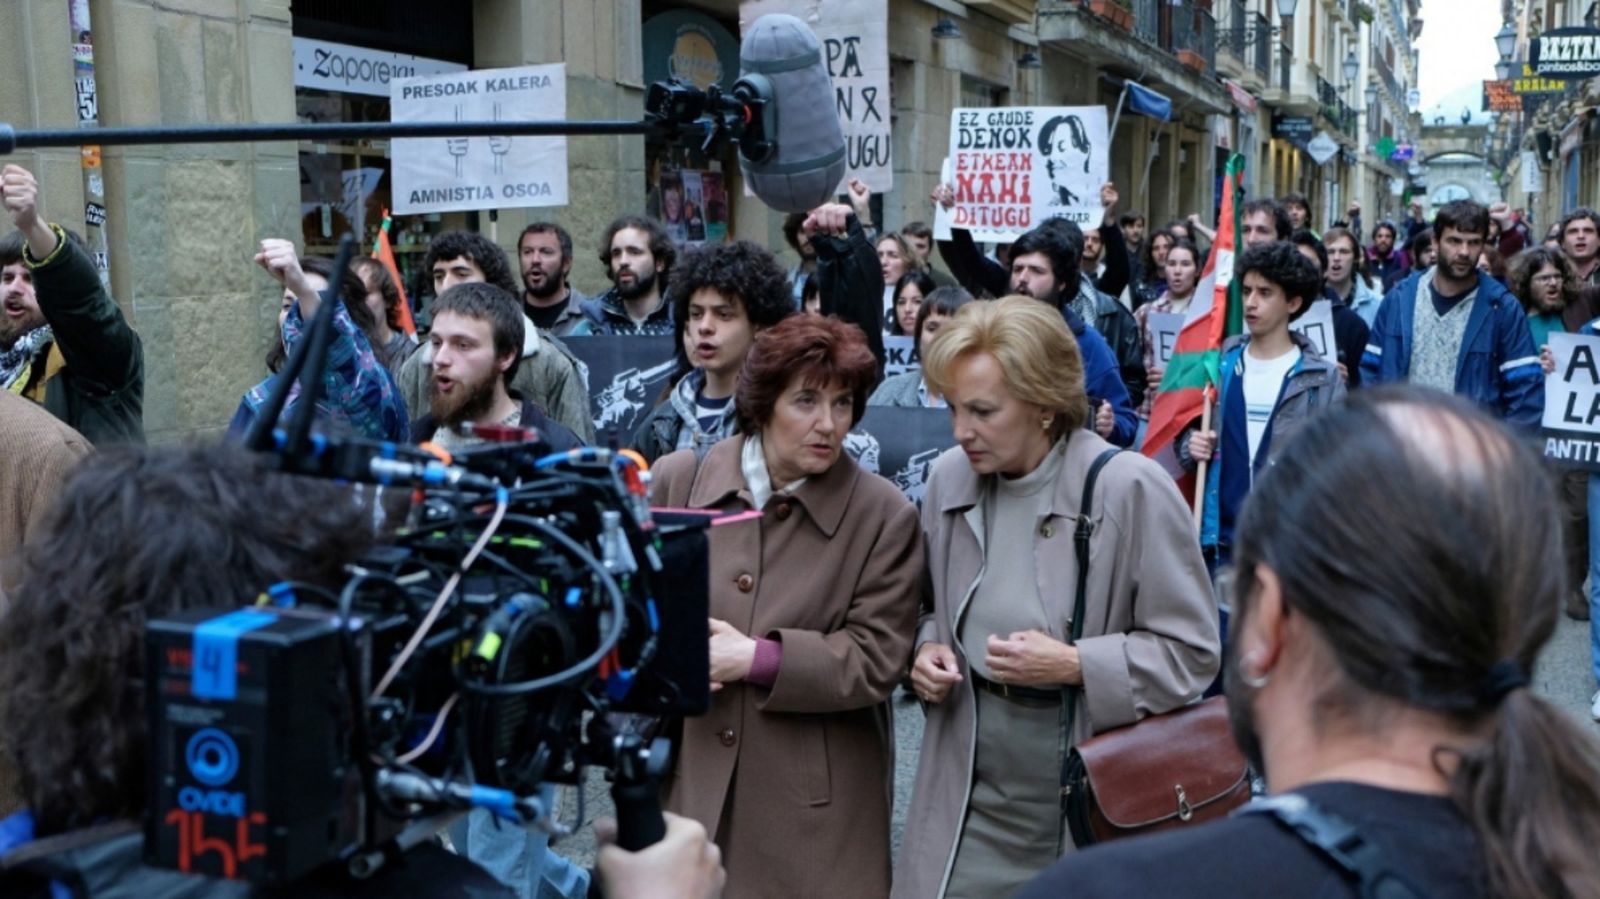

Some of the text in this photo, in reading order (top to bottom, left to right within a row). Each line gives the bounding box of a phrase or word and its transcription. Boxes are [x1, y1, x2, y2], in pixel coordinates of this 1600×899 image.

[403, 75, 552, 99] PRESOAK KALERA
[959, 111, 1034, 126] EZ GAUDE
[957, 127, 1032, 149] DENOK
[844, 134, 890, 169] UGU
[957, 152, 1032, 171] ETXEAN
[409, 182, 552, 204] AMNISTIA OSOA
